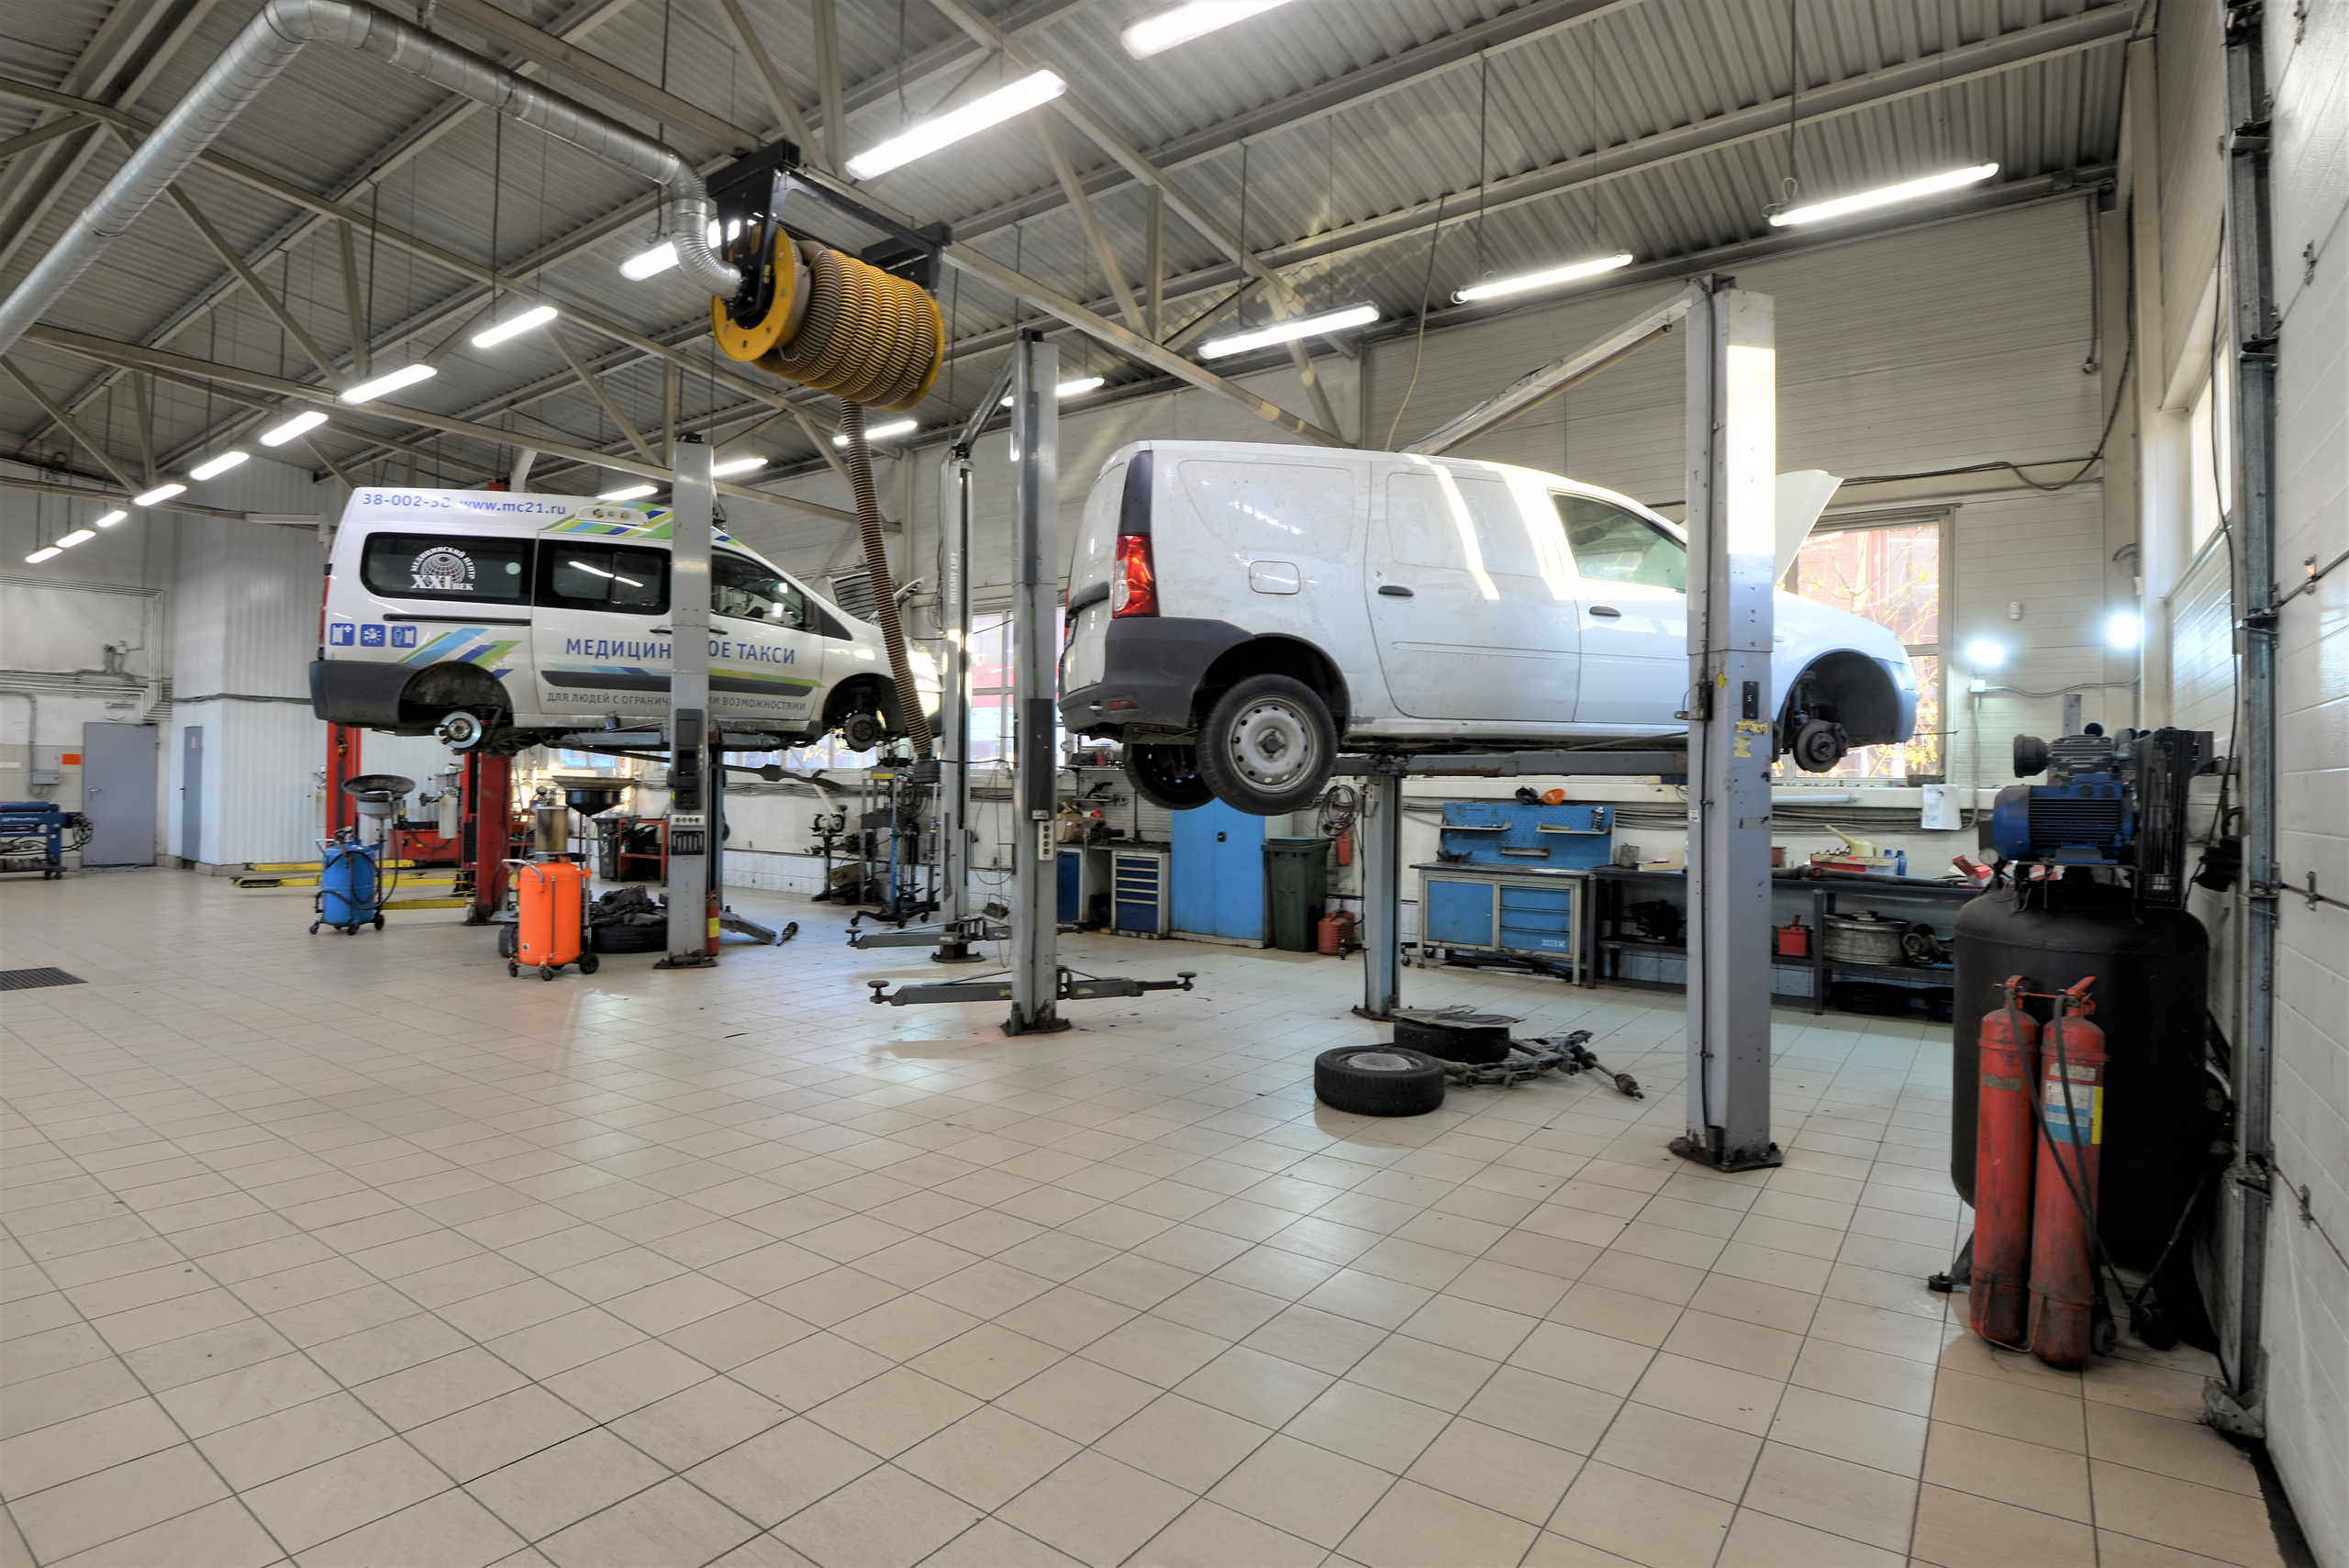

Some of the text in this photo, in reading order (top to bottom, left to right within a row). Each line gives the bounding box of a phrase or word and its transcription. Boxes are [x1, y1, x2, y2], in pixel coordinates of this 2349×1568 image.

[460, 499, 566, 515] www.mc21.ru
[409, 546, 476, 580] МЕДИЦИНСКИЙ ЦЕНТР
[409, 574, 452, 590] XXI
[950, 551, 958, 605] ROTARY LIFT
[566, 638, 796, 664] МЕДИЦИНОЕ ТАКСИ
[547, 693, 569, 703] ДЛЯ
[571, 694, 610, 705] ЛЮДЕЙ
[723, 697, 807, 711] ВОЗМОЖНОСТЯМИ
